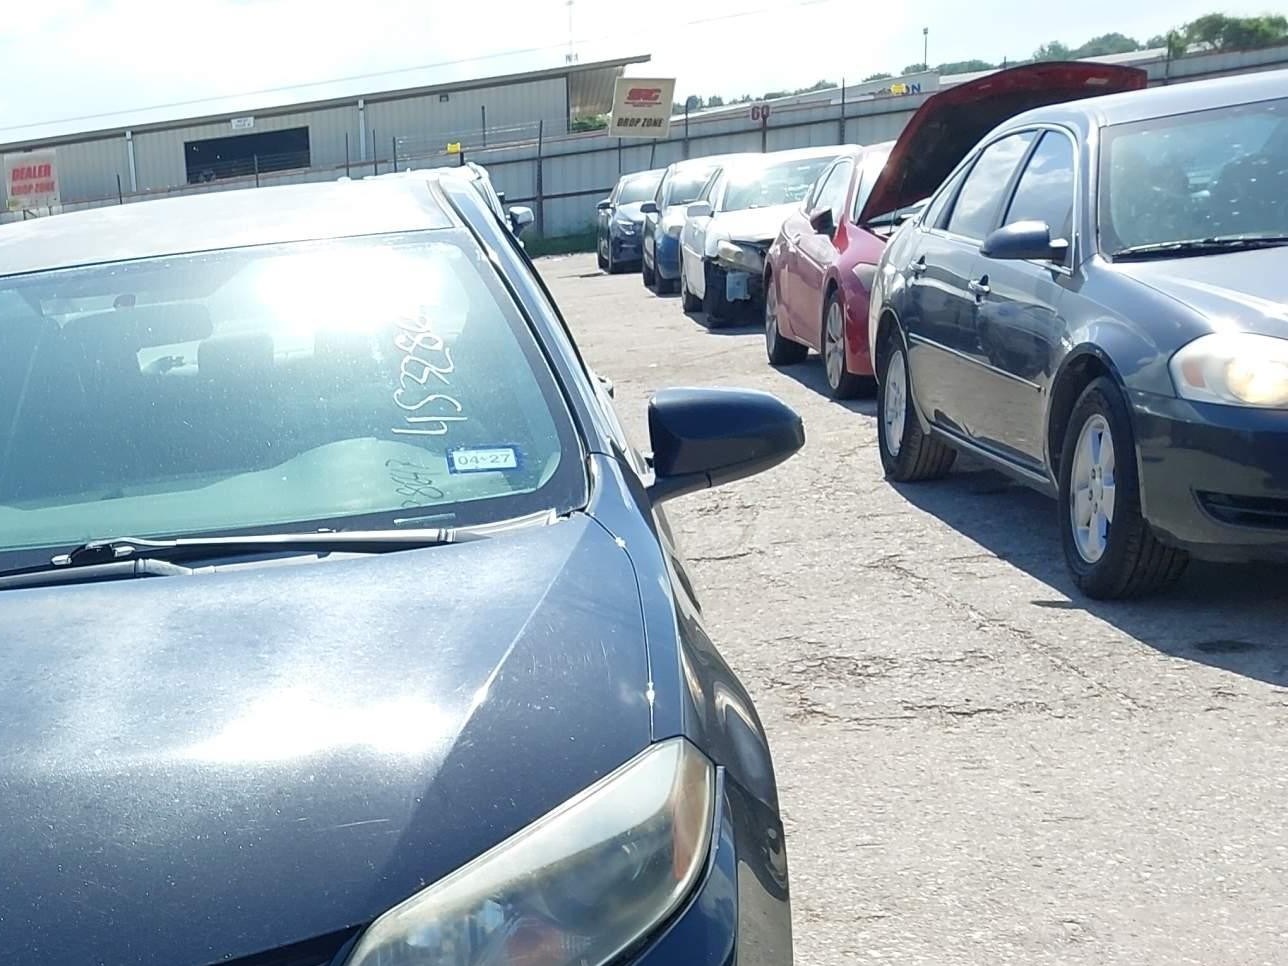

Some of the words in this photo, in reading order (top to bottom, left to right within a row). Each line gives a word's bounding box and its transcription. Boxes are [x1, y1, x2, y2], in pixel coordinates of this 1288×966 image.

[617, 117, 640, 128] DROP
[642, 117, 664, 128] ZONE
[12, 164, 51, 182] DEALER
